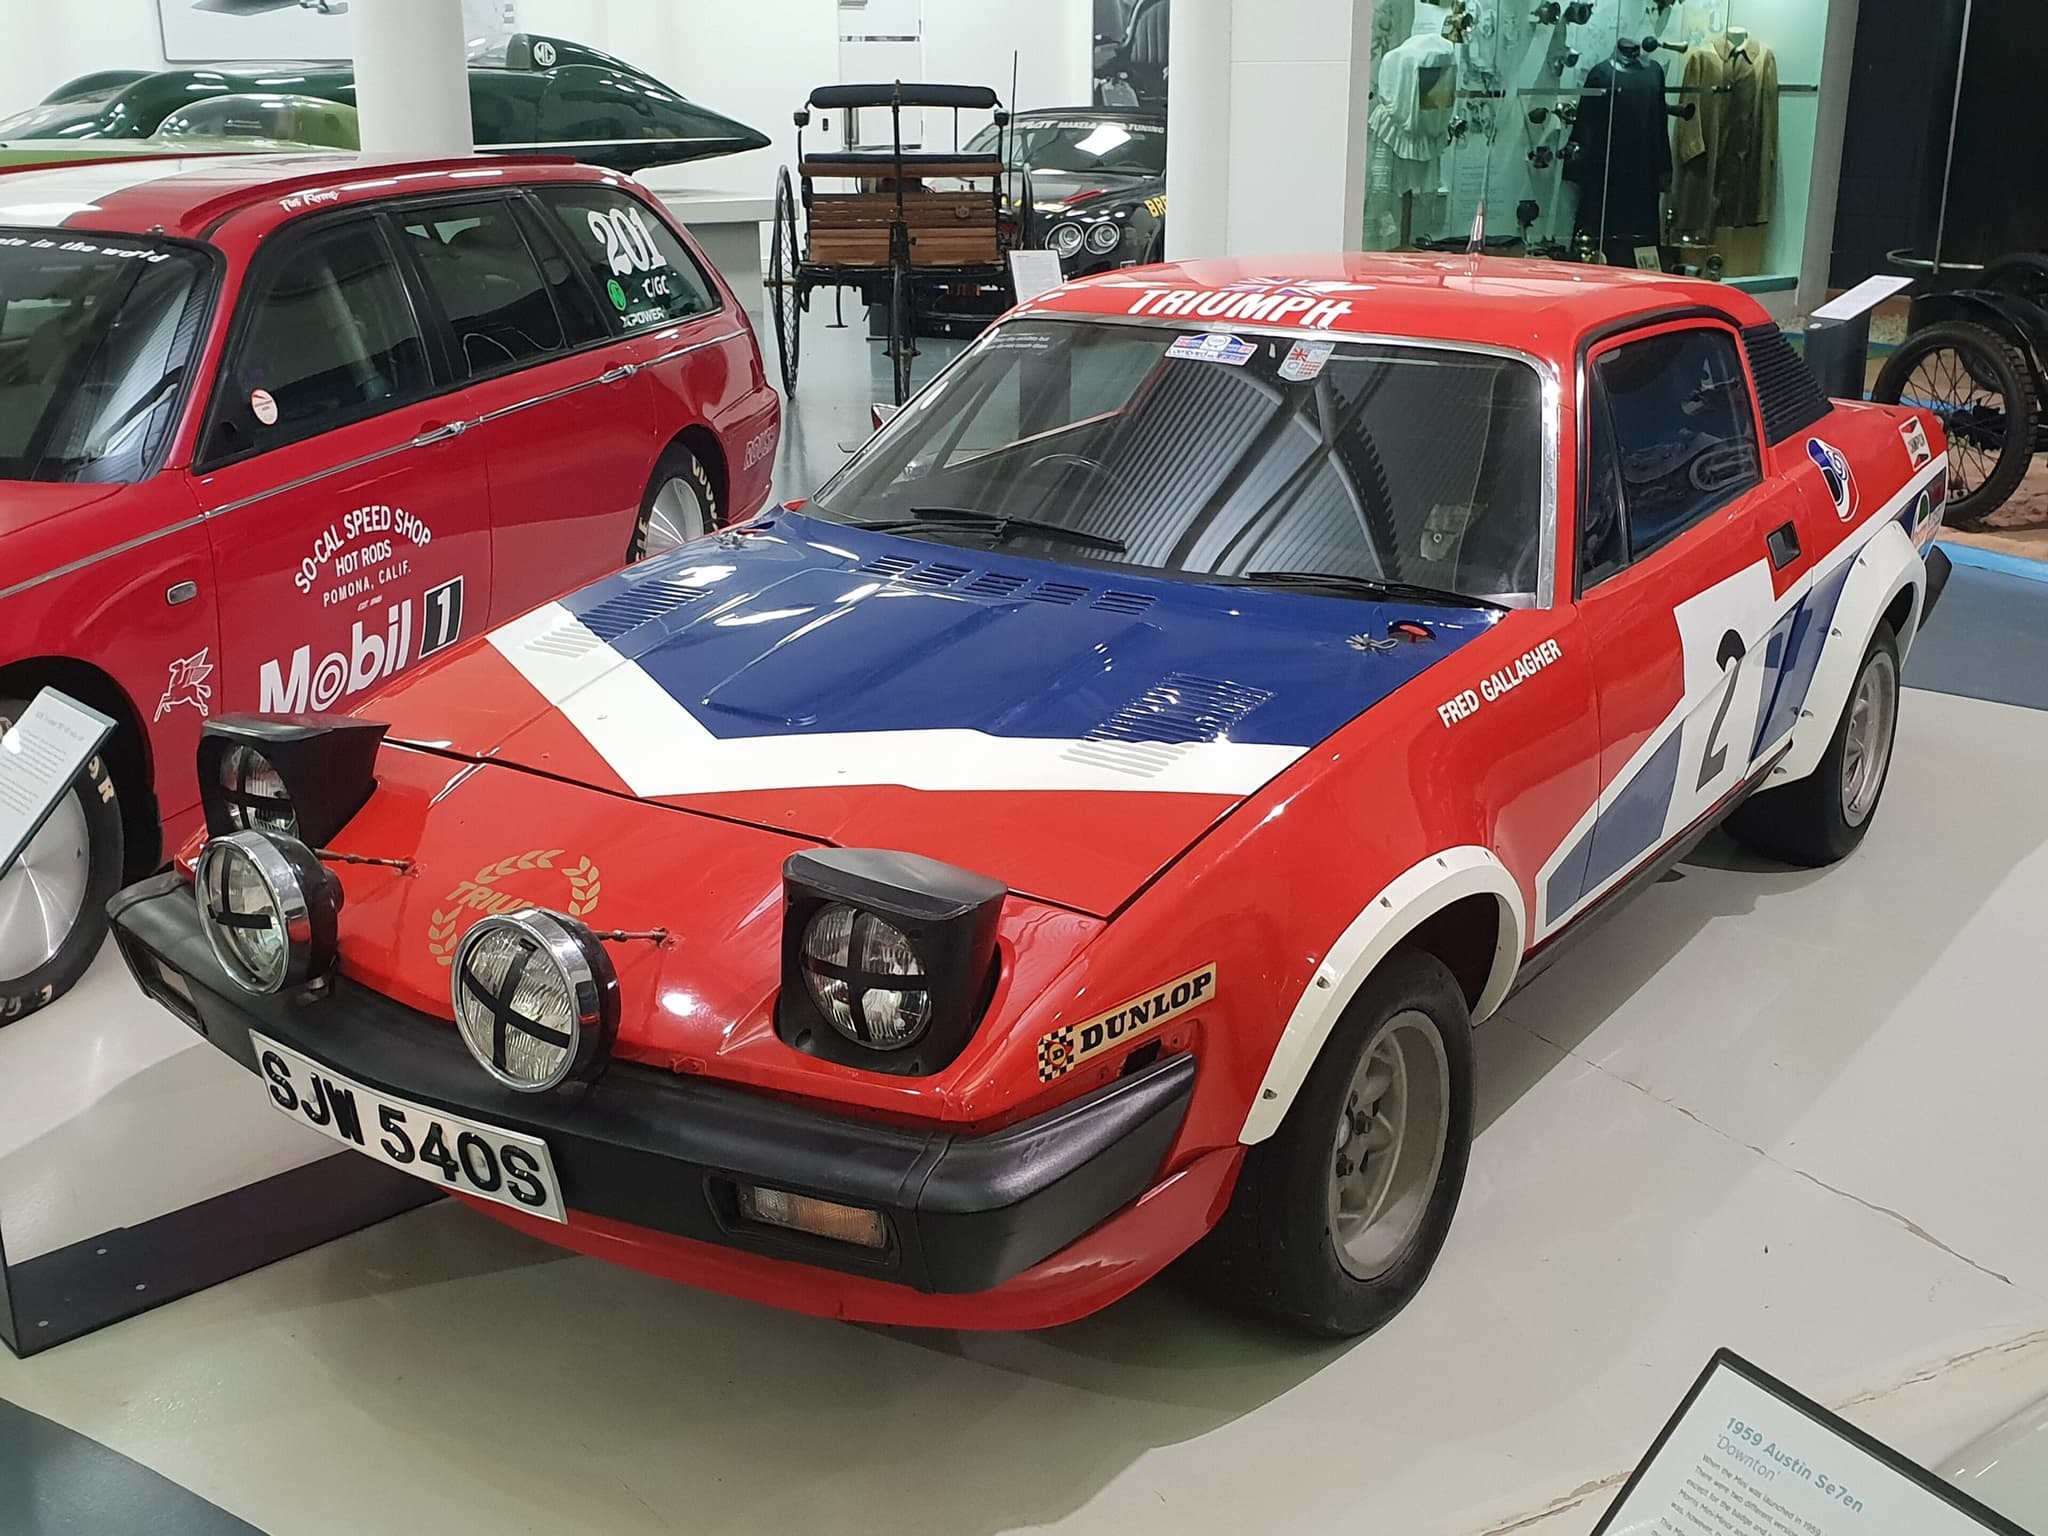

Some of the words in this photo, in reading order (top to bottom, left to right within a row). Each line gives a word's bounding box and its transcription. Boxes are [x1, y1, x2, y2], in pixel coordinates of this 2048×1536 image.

[535, 44, 555, 64] MG
[1127, 123, 1165, 134] TUNING
[30, 239, 55, 248] in
[59, 241, 98, 252] the
[101, 247, 170, 263] world
[587, 207, 667, 277] 201
[1128, 289, 1353, 326] TRIUMPH
[295, 524, 344, 594] SO-CAL
[343, 505, 391, 540] SPEED
[394, 508, 431, 548] SHOP
[335, 551, 359, 578] HOT
[361, 539, 392, 567] RODS
[323, 575, 374, 608] POMONA,
[378, 559, 412, 584] CALIF.
[259, 598, 412, 714] Mobil
[437, 586, 451, 646] 1
[1437, 689, 1479, 728] FRED
[1480, 638, 1562, 701] GALLAGHER
[1696, 629, 1746, 792] 2
[445, 881, 535, 915] TRIU
[1080, 971, 1212, 1054] DUNLOP
[262, 1050, 365, 1146] SJW
[378, 1103, 547, 1207] 540S
[1725, 1417, 1763, 1447] 1959
[1763, 1442, 1812, 1480] Austin
[1814, 1474, 1864, 1514] Se7en
[1762, 1495, 1795, 1520] launched
